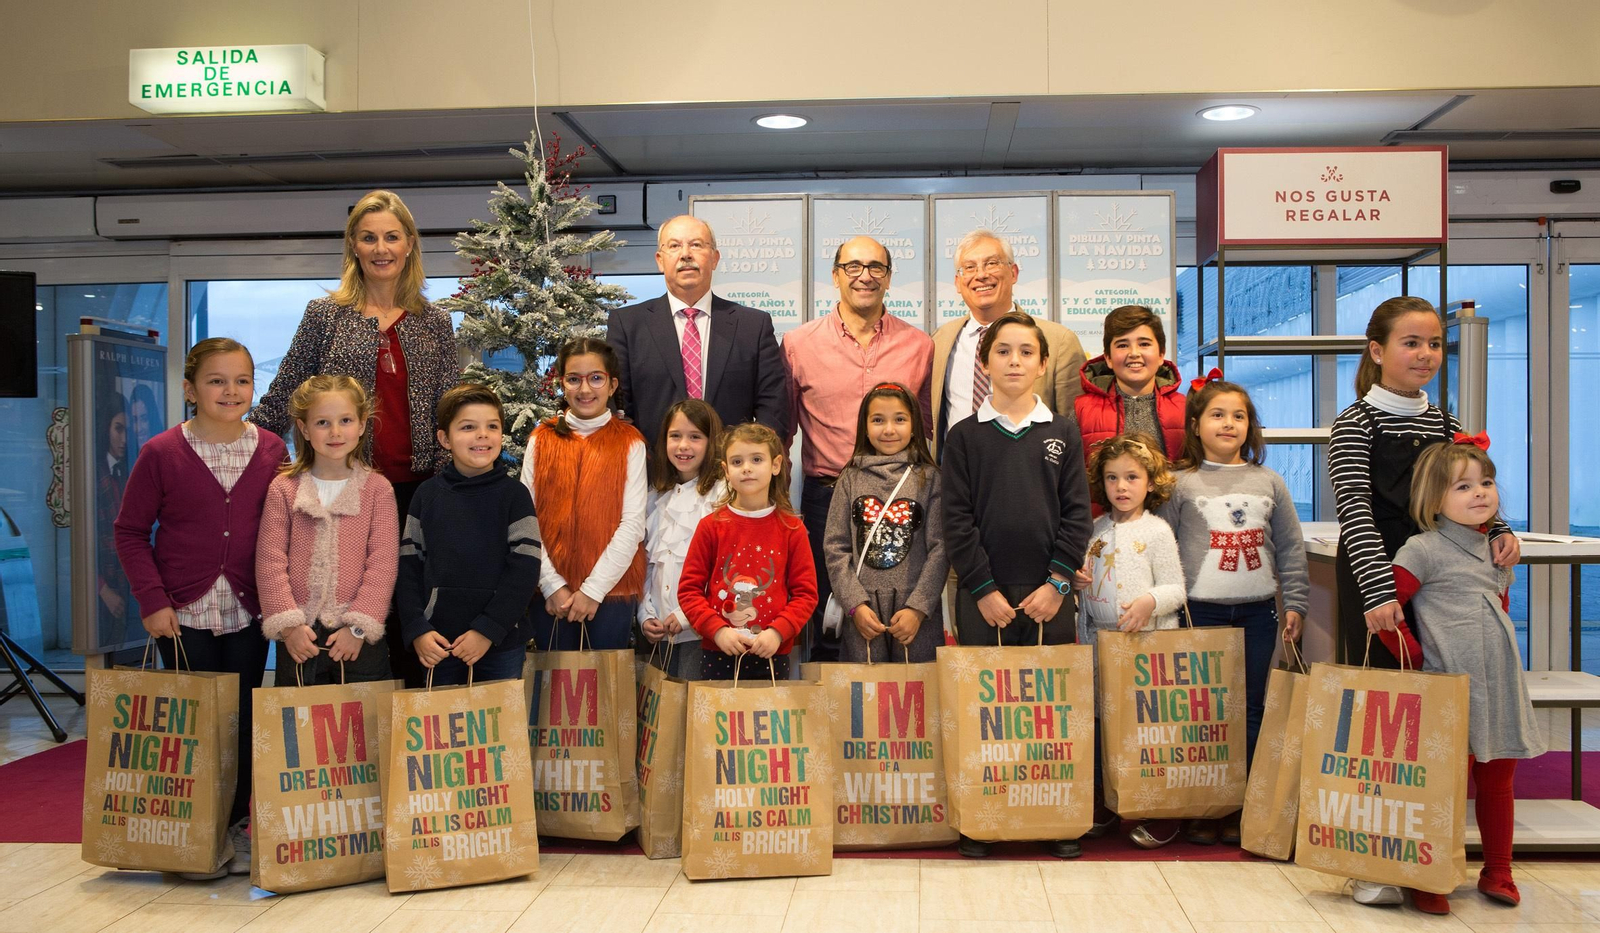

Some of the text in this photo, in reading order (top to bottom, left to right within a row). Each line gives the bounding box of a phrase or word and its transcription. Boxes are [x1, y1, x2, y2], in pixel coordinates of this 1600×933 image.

[176, 49, 258, 65] SALIDA
[204, 66, 230, 80] DE
[141, 80, 292, 98] EMERGENCIA
[1275, 190, 1390, 202] NOS GUSTA
[1286, 209, 1381, 222] REGALAR
[716, 237, 793, 247] BUJA Y PINTA
[1068, 244, 1164, 256] LA NAVIDAD
[1069, 234, 1161, 244] DIBUJA Y PINTA
[728, 248, 796, 259] NAVIDAD
[1098, 258, 1135, 271] 2019
[732, 261, 768, 273] 2019
[759, 299, 785, 307] AÑOS
[1067, 306, 1112, 315] EDUCACIÓ
[100, 351, 159, 367] RALPH LAUREN
[1134, 651, 1224, 686] SILENT
[529, 669, 597, 726] I'M
[978, 668, 1070, 703] SILENT
[113, 693, 199, 735] SILENT
[850, 681, 925, 739] I'M
[1136, 688, 1228, 723] NIGHT
[282, 701, 367, 768] I'M
[406, 707, 502, 751] SILENT
[715, 709, 806, 746] SILENT
[980, 705, 1072, 740] NIGHT
[1138, 724, 1228, 746] HOLY NIGHT
[1334, 689, 1422, 762] I'M
[528, 728, 604, 747] REAMING
[843, 740, 933, 760] DREAMING
[108, 732, 198, 775] NIGHT
[550, 748, 570, 758] OF A
[981, 742, 1073, 763] HOLY NIGHT
[1140, 745, 1228, 764] ALL IS CALM
[280, 764, 378, 792] DREAMING
[406, 745, 506, 792] NIGHT
[716, 747, 809, 785] NIGHT
[880, 762, 900, 772] OF A
[983, 763, 1074, 782] ALL IS CALM
[1141, 764, 1228, 789] ALL IS BRIGHT
[1321, 753, 1427, 788] DREAMING
[105, 771, 195, 798] HOLY NIGHT
[321, 788, 342, 800] OF A
[715, 786, 810, 807] HOLY NIGHT
[844, 772, 936, 804] WHITE
[983, 783, 1073, 808] ALL IS BRIGHT
[1358, 782, 1382, 796] OF A
[103, 794, 192, 820] ALL IS CALM
[409, 784, 509, 814] HOLY NIGHT
[534, 792, 612, 812] RISTMAS
[282, 796, 383, 840] WHITE
[412, 807, 512, 836] ALL IS CALM
[714, 808, 811, 829] ALL IS CALM
[838, 804, 944, 825] CHRISTMAS
[1318, 788, 1425, 840] WHITE
[102, 815, 190, 847] ALL IS BRIGHT
[714, 828, 811, 855] ALL IS BRIGHT
[412, 827, 512, 861] ALL IS BRIGHT
[1308, 823, 1433, 866] CHRISTMAS
